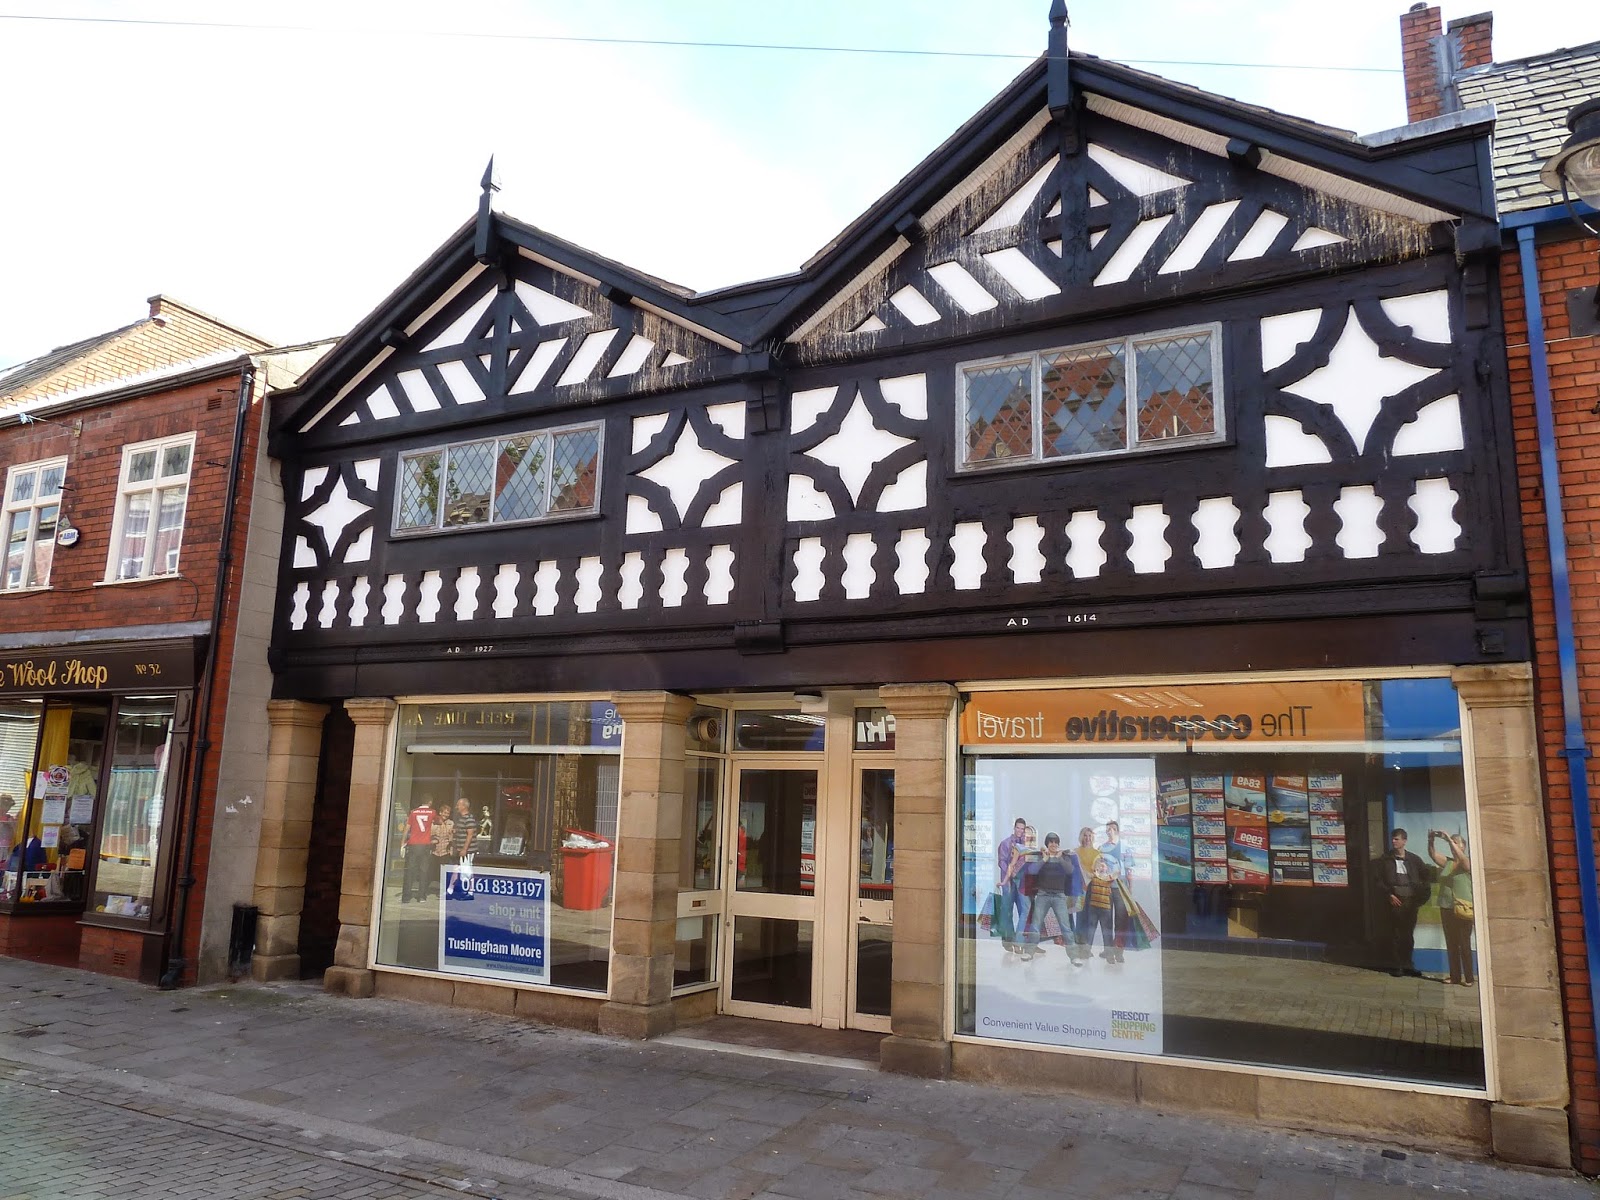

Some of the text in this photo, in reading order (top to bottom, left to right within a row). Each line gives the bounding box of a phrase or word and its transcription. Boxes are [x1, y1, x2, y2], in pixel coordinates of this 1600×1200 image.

[1066, 613, 1097, 623] 1614
[474, 645, 494, 653] 1927
[7, 660, 57, 687] Wool
[61, 659, 108, 689] Shop
[461, 877, 542, 898] 0161 833 1197
[488, 903, 541, 920] shop unit
[510, 920, 541, 937] to let
[448, 937, 542, 959] Tushingham Moore
[1111, 1009, 1150, 1022] PRESCOT
[982, 1016, 1107, 1039] Convenient Value Shopping
[1111, 1019, 1156, 1033] SHOPPING
[1111, 1029, 1145, 1041] CENTRE
